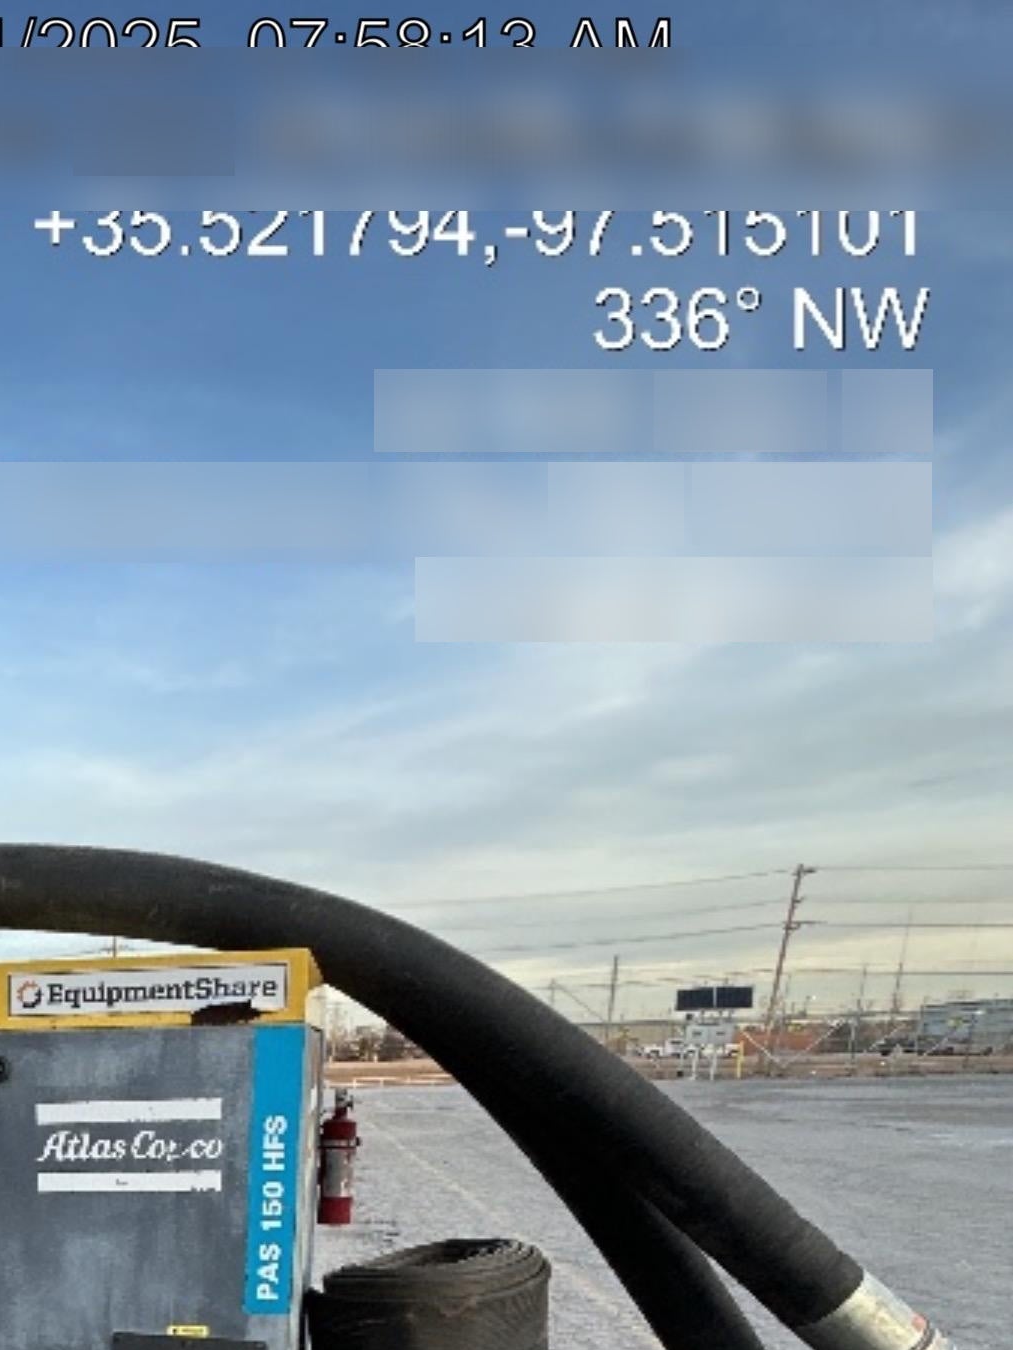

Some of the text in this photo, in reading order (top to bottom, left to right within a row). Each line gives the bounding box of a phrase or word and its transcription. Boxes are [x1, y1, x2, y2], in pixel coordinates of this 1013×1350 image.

[46, 977, 279, 1008] EquipmentShare
[36, 1130, 127, 1162] Atlas
[256, 1114, 288, 1301] PAS 150 HFS
